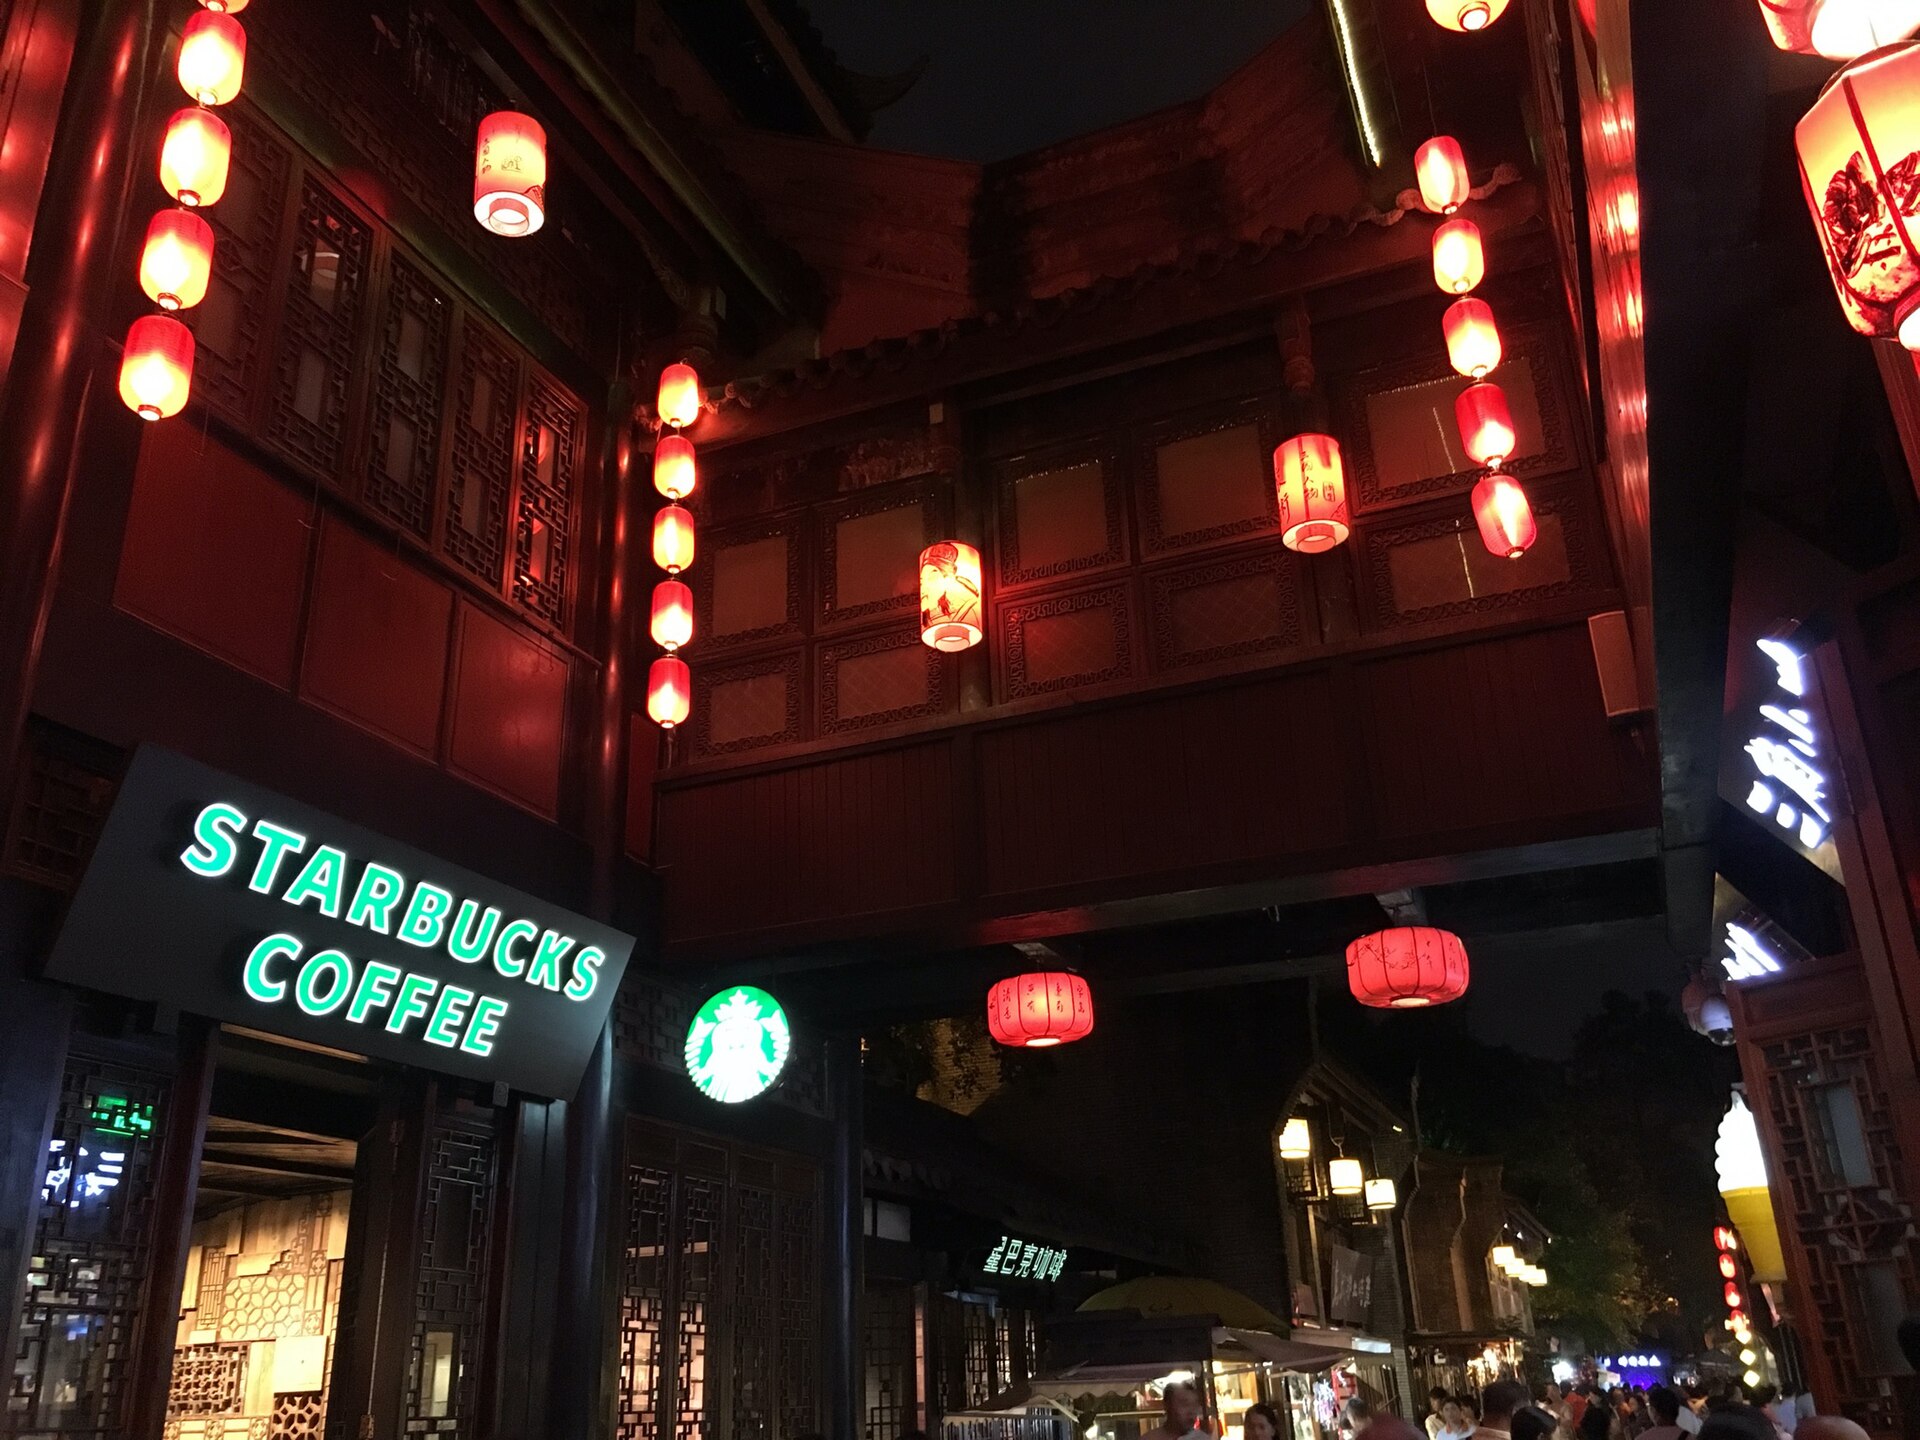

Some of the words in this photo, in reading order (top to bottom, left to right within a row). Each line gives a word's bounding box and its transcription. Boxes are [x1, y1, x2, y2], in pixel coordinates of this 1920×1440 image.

[179, 802, 607, 1002] STARBUCKS
[243, 933, 509, 1057] COFFEE
[983, 1235, 1068, 1283] 星巴克咖啡
